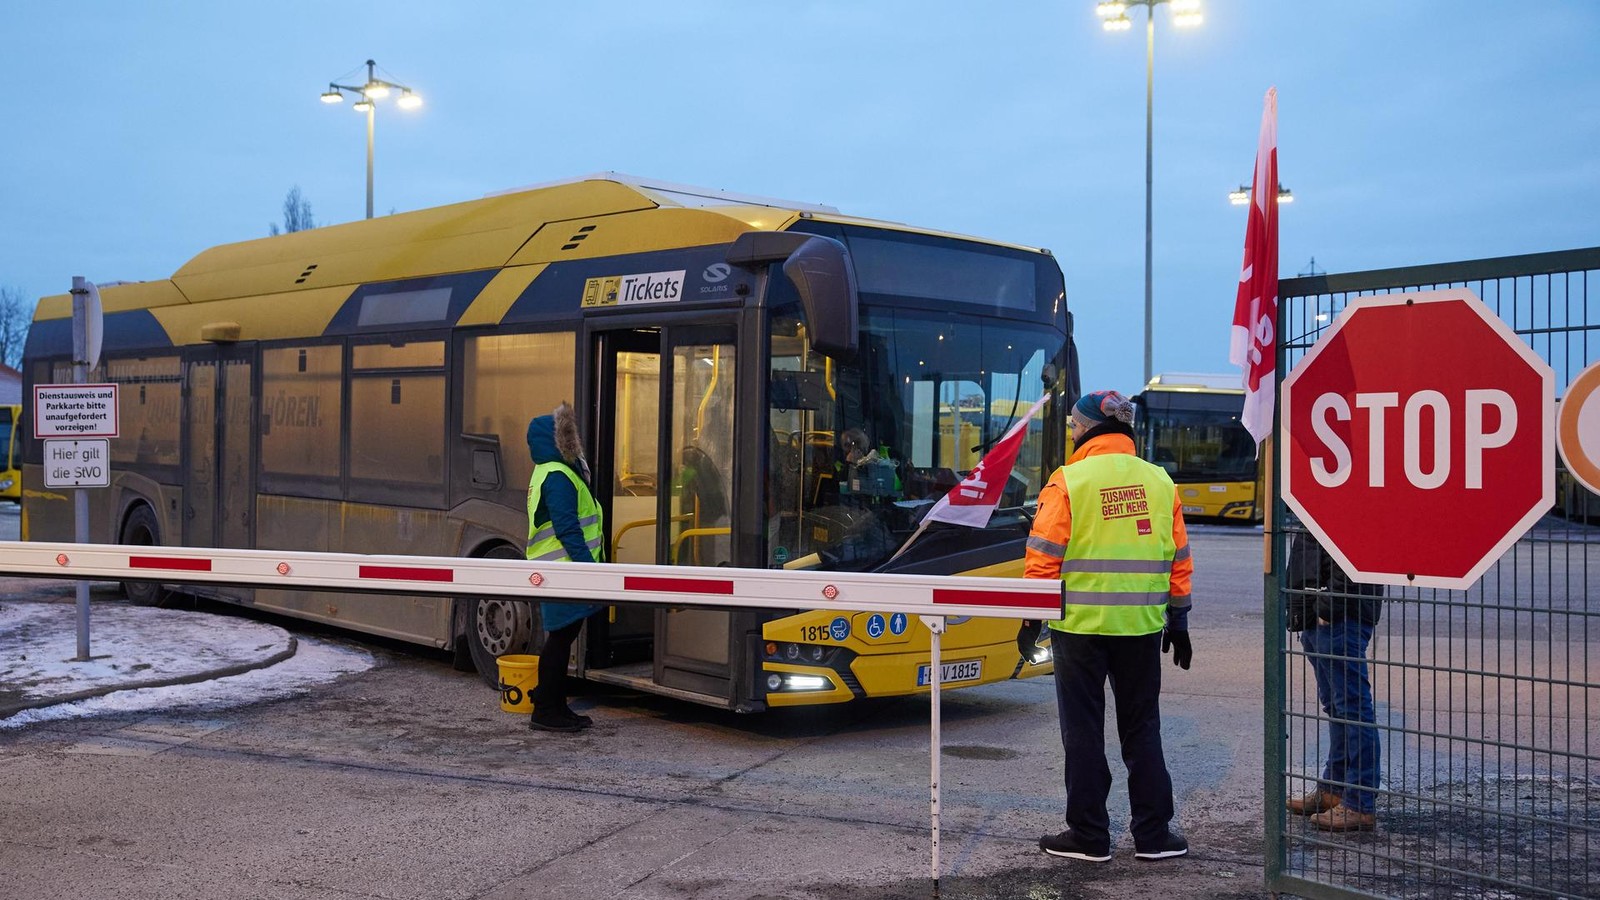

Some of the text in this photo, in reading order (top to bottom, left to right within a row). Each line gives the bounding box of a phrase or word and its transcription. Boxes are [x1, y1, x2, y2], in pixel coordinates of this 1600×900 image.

[625, 277, 679, 301] Tickets
[700, 285, 728, 293] SOLARIS
[39, 390, 113, 400] Dienstausweis und
[46, 402, 106, 410] Parkkarte bitte
[45, 412, 107, 422] unaufgefordert
[55, 423, 97, 432] vorzeigen!
[1309, 388, 1519, 490] STOP
[53, 447, 100, 462] Hier gilt
[53, 466, 101, 479] die StVO
[1100, 488, 1146, 504] ZUSAMMEN
[1102, 501, 1149, 516] GEHT MEHR
[800, 624, 831, 642] 1815
[951, 662, 978, 681] 1815
